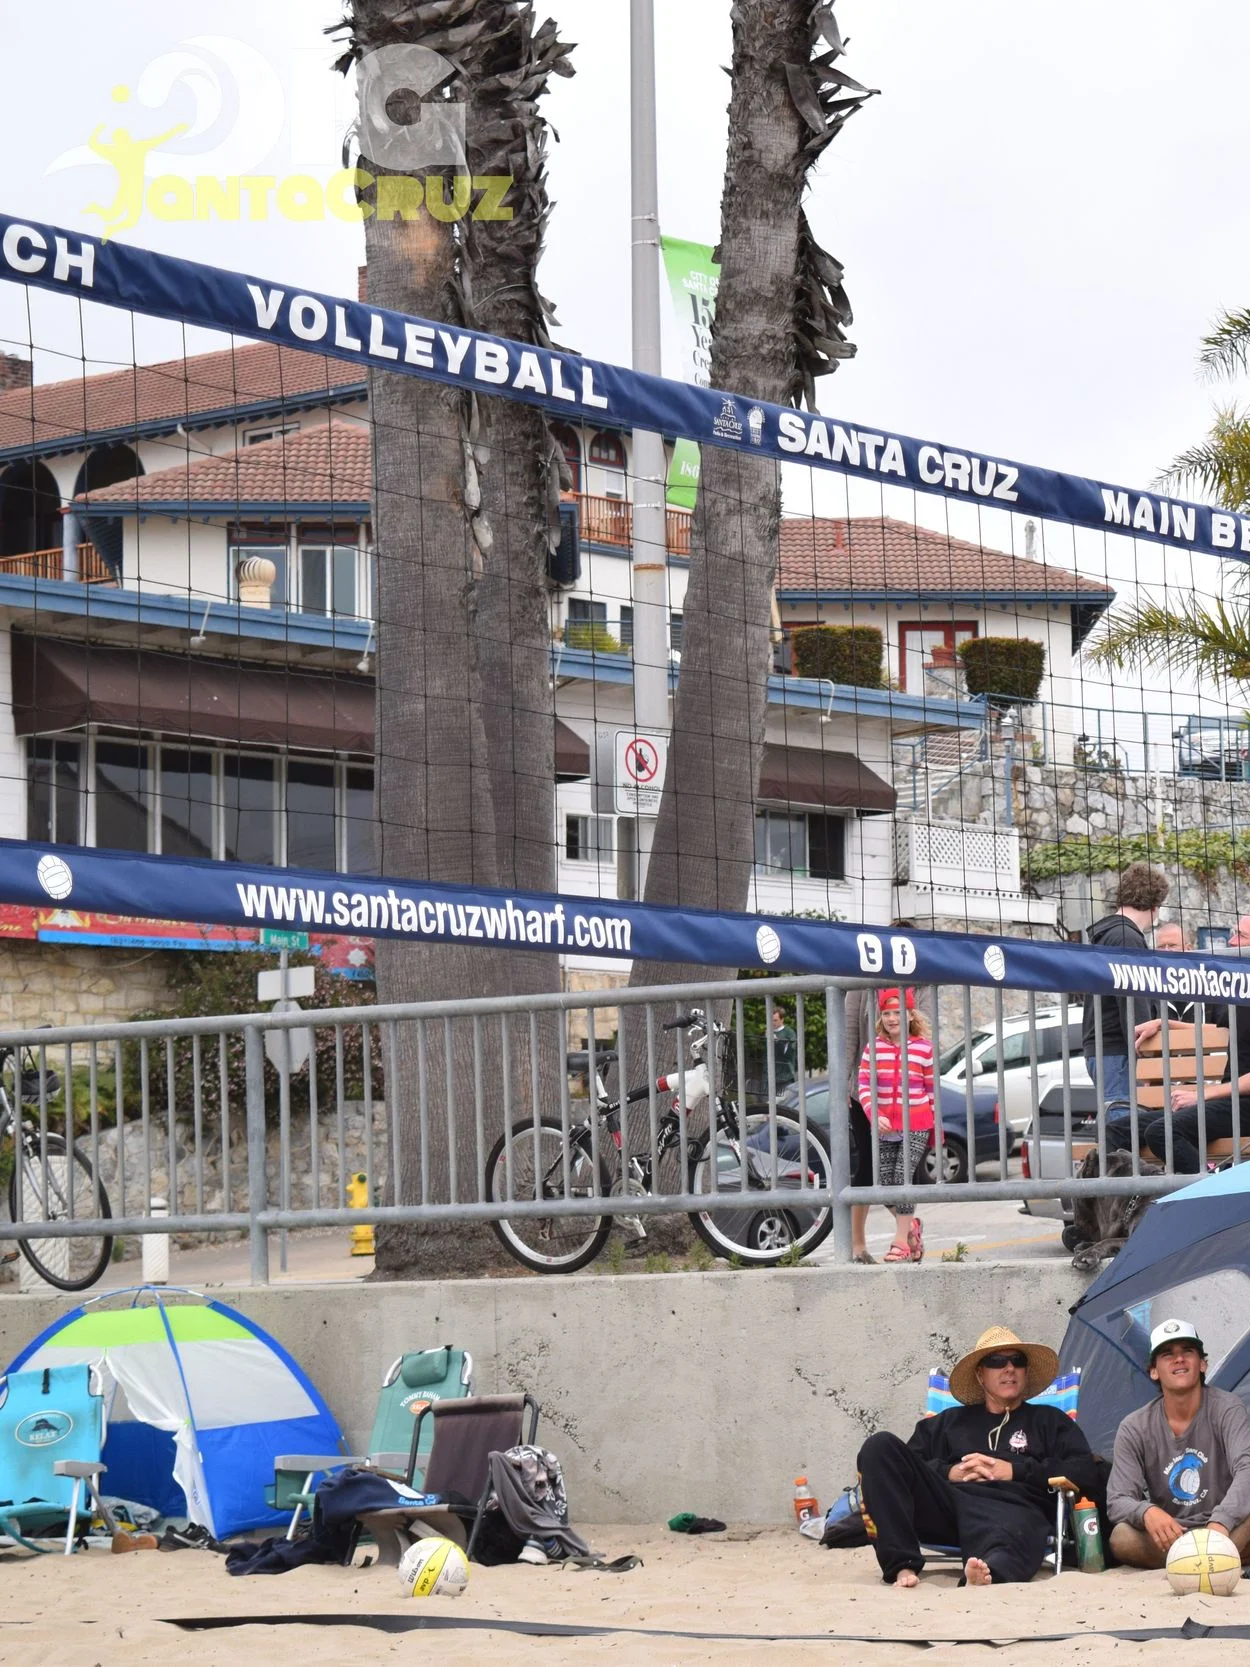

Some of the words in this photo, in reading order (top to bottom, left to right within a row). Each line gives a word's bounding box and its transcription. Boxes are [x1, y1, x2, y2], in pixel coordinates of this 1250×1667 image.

[246, 282, 609, 410] VOLLEYBALL
[777, 411, 907, 477] SANTA
[918, 444, 1020, 503] CRUZ
[1101, 487, 1197, 541] MAIN
[236, 883, 631, 951] www.santacruzwharf.com
[270, 934, 289, 947] Main
[800, 1508, 810, 1521] G
[407, 1558, 425, 1584] Wilson
